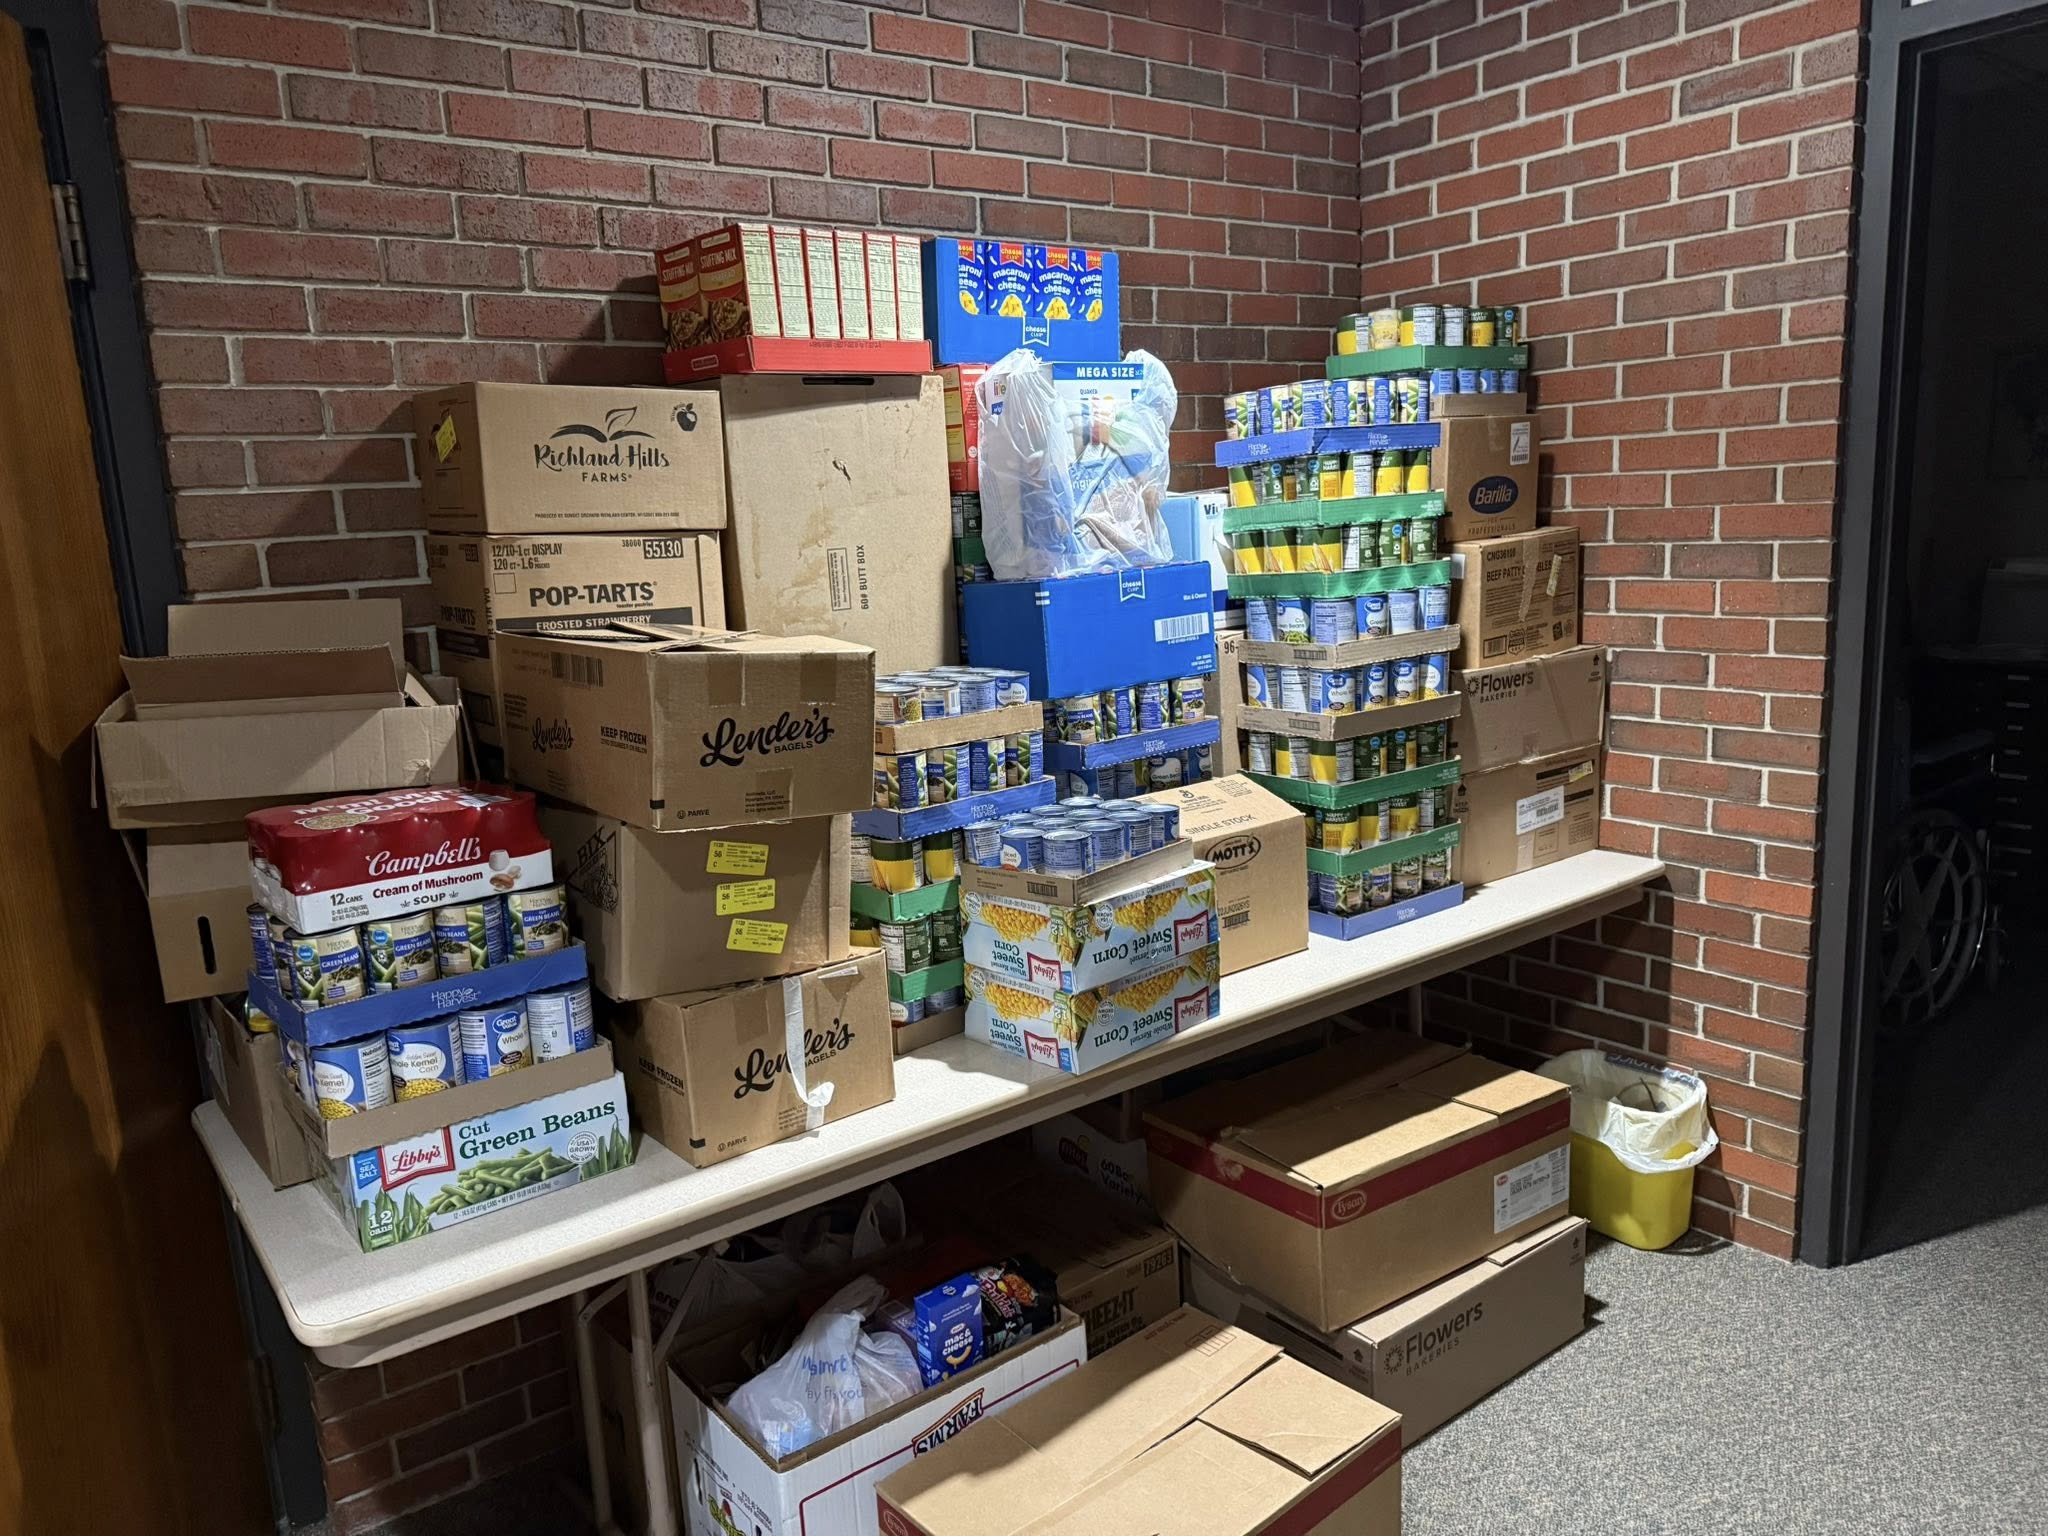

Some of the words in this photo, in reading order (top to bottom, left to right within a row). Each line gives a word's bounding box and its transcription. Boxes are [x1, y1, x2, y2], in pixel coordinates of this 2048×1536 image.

[959, 264, 982, 278] aroni
[993, 268, 1030, 282] macaroni
[1039, 271, 1075, 285] macaroni
[998, 281, 1026, 292] cheese
[1044, 284, 1071, 296] cheese
[1076, 366, 1109, 378] MEGA
[1112, 366, 1134, 378] SIZE
[534, 444, 623, 472] Richland
[627, 445, 670, 471] Hills
[582, 472, 627, 482] FARMS
[1475, 486, 1512, 506] Barilla
[1468, 523, 1516, 535] PROFESSIONALS
[492, 545, 523, 557] 12/10-1
[532, 543, 562, 556] DISPLAY
[622, 539, 641, 547] 38000
[645, 540, 682, 557] 55130
[856, 545, 866, 564] BOX
[494, 559, 508, 570] 120
[858, 567, 868, 591] BUTT
[1486, 570, 1502, 582] BEEF
[1502, 565, 1521, 578] PATTY
[530, 582, 654, 607] POP-TARTS
[536, 618, 583, 631] FROSTED
[585, 614, 652, 629] STRAWBERRY
[1480, 671, 1534, 694] Flowers
[1480, 690, 1517, 703] BAKERIES
[532, 717, 574, 753] Lender's
[600, 725, 618, 739] KEEP
[620, 729, 647, 746] FROZEN
[700, 708, 835, 767] Lender's
[774, 739, 814, 754] BAGELS
[687, 809, 709, 817] PARVE
[1185, 822, 1221, 835] SINGLE
[1223, 814, 1257, 828] STOCK
[366, 838, 481, 876] Campbell's
[1211, 840, 1256, 862] MOTT'S
[373, 886, 409, 899] Cream
[411, 881, 423, 892] of
[425, 872, 483, 889] Mushroom
[330, 893, 344, 906] 12
[345, 895, 363, 904] CANS
[413, 893, 446, 906] SOUP
[543, 911, 560, 920] BEANS
[1051, 925, 1064, 936] 12
[1075, 924, 1089, 938] 12
[1134, 927, 1172, 951] Sweet
[1181, 923, 1204, 942] Libby's
[395, 942, 416, 952] GREEN
[417, 937, 432, 948] BEANS
[994, 939, 1020, 956] Corn
[321, 959, 343, 968] GREEN
[343, 952, 359, 964] BEANS
[991, 951, 1024, 969] Sweet
[1092, 943, 1129, 964] Corn
[1034, 963, 1057, 982] Libby's
[431, 988, 466, 1002] Happy
[437, 991, 478, 1009] Harvest
[1054, 1008, 1067, 1020] 12
[1181, 1000, 1204, 1019] Libby's
[497, 1015, 518, 1027] Great
[992, 1018, 1017, 1035] Corn
[1133, 1006, 1173, 1034] Sweet
[1153, 1021, 1174, 1034] Whole
[501, 1033, 523, 1045] Whole
[990, 1028, 1022, 1047] Sweet
[1094, 1025, 1129, 1047] Corn
[1130, 1029, 1152, 1046] Kernel
[805, 1049, 837, 1068] AGELS
[1030, 1041, 1056, 1059] Libby's
[410, 1058, 438, 1067] Kernel
[419, 1065, 439, 1074] Corn
[638, 1056, 655, 1072] KEEP
[656, 1066, 684, 1089] FROZEN
[320, 1079, 345, 1087] Kernel
[327, 1086, 346, 1094] Corn
[459, 1121, 490, 1139] Cut
[460, 1126, 537, 1160] Green
[541, 1100, 616, 1135] Beans
[727, 1136, 748, 1148] PARVE
[359, 1163, 376, 1173] SEA
[389, 1145, 441, 1175] Libby's
[359, 1170, 378, 1180] SALT
[1100, 1170, 1143, 1205] Variety
[1336, 1194, 1363, 1215] Tyson
[368, 1210, 393, 1229] 12
[369, 1223, 393, 1237] cans
[944, 1331, 964, 1347] mac
[964, 1328, 972, 1338] &
[1405, 1302, 1483, 1363] Flowers
[1405, 1336, 1460, 1377] BAKERIES
